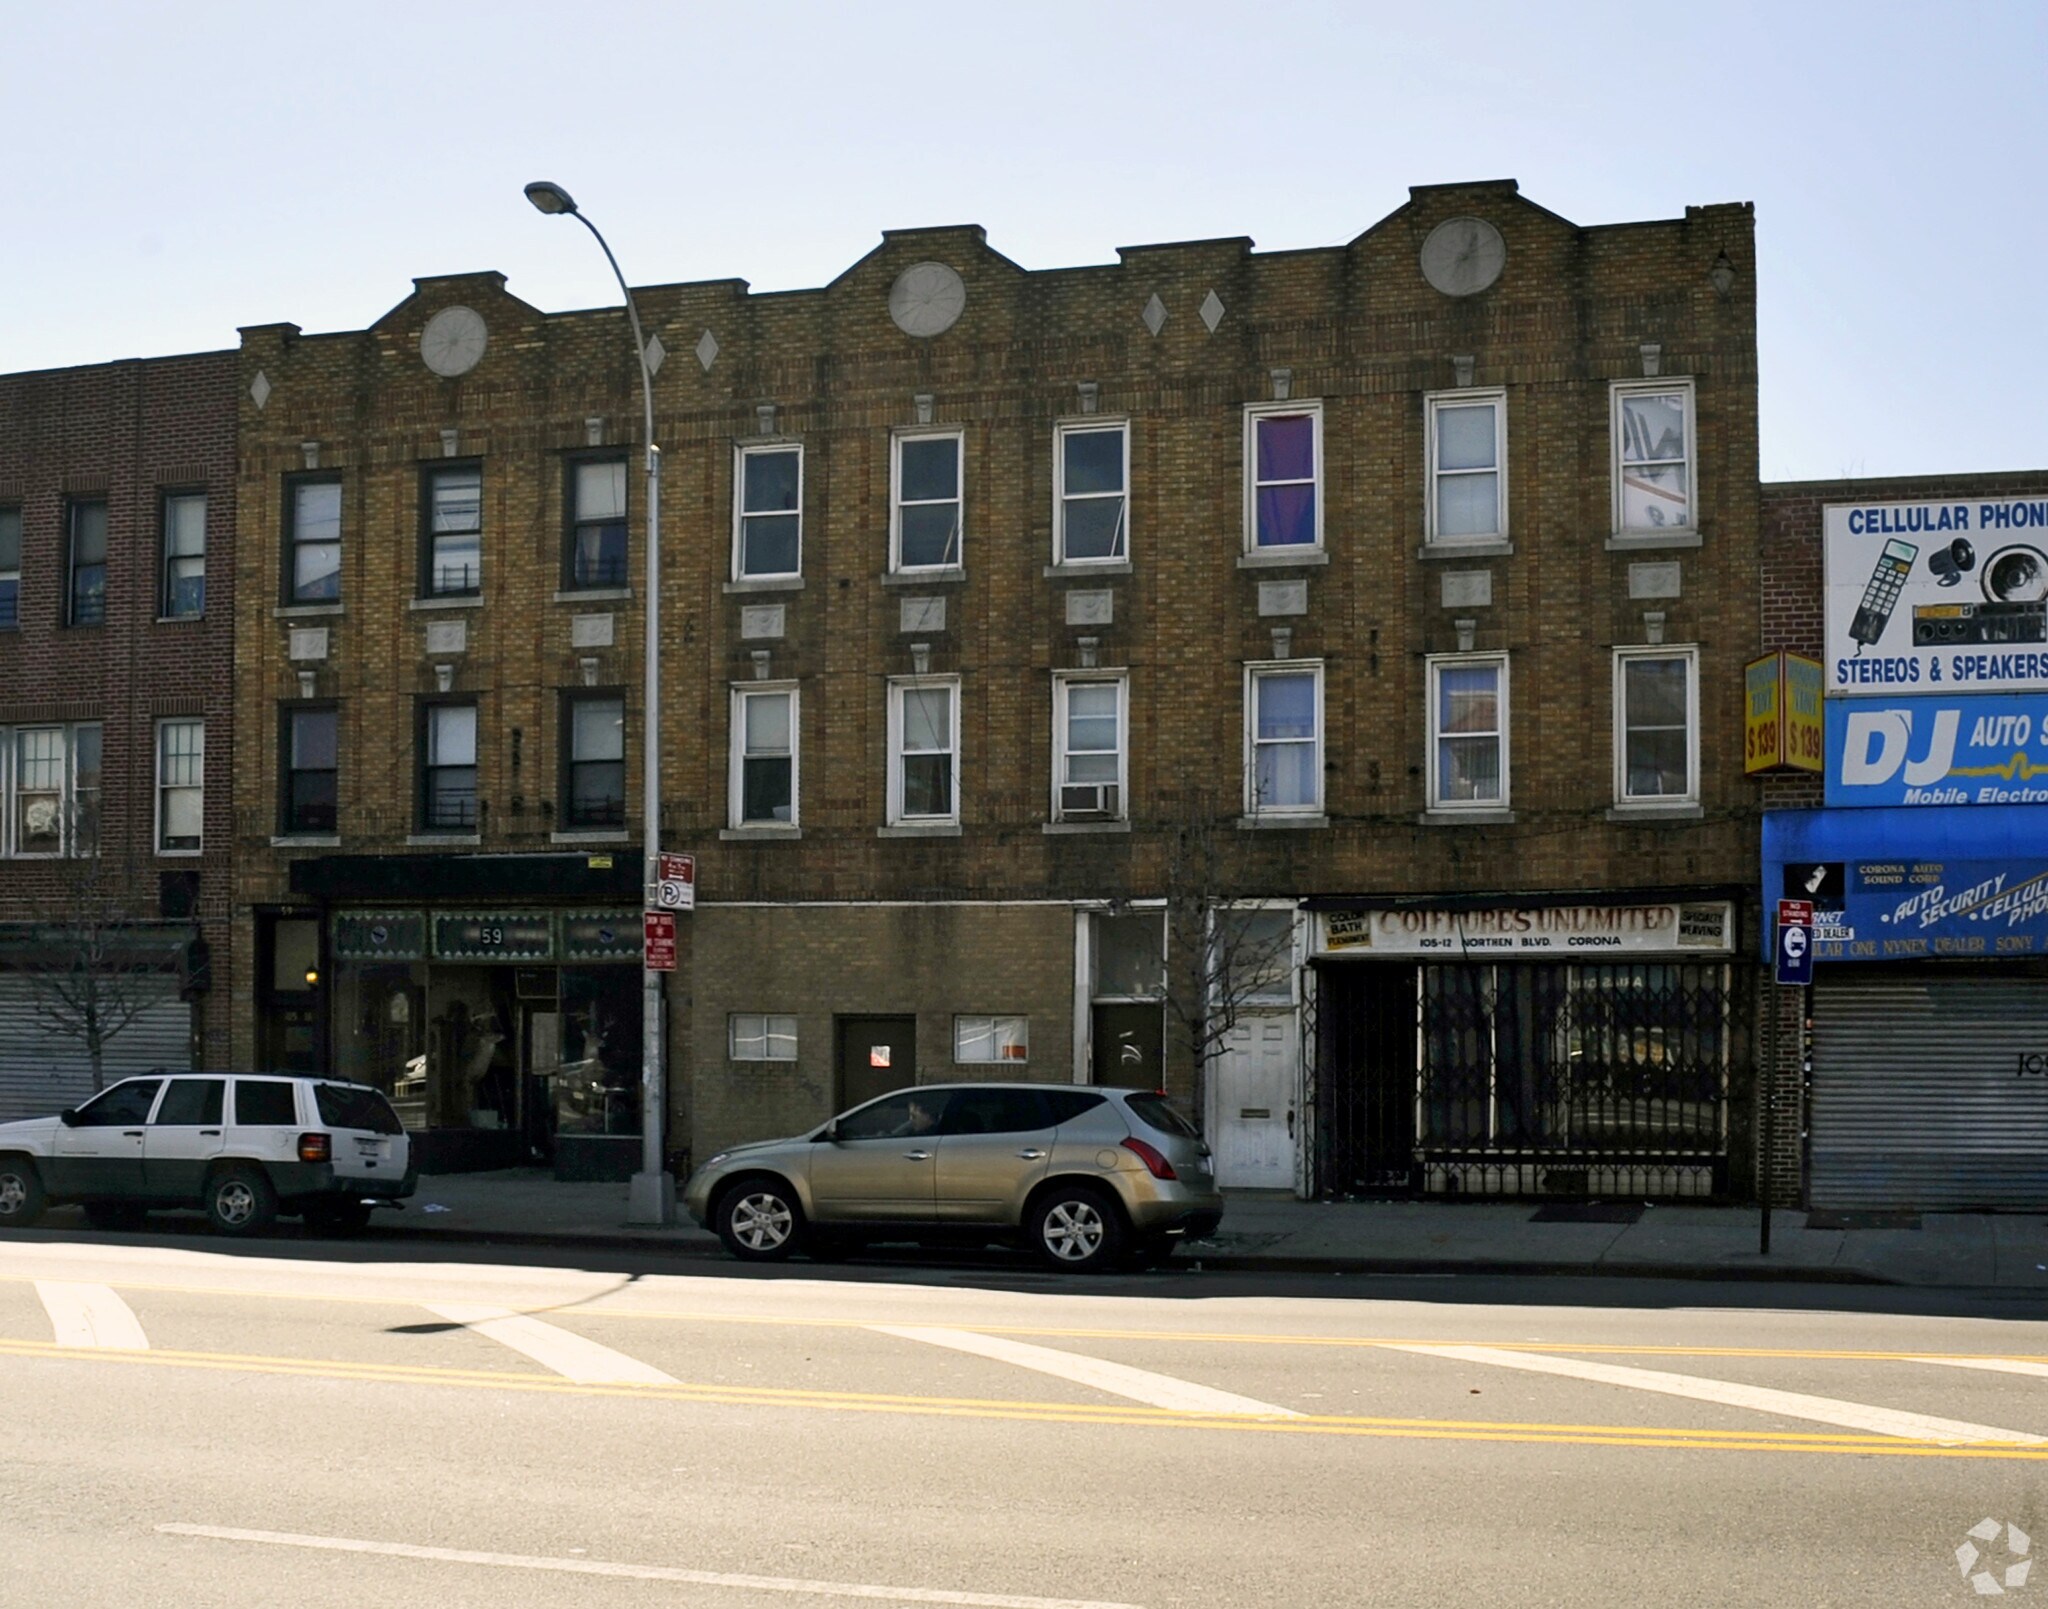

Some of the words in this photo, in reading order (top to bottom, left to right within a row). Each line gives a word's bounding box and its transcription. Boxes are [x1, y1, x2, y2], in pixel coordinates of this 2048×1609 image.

[1849, 506, 1969, 534] CELLULAR
[1980, 502, 2048, 529] PHON
[1837, 656, 1920, 684] STEREOS
[1930, 655, 1942, 682] &
[1841, 709, 1961, 787] DJ
[1969, 715, 2031, 747] AUTO
[1903, 788, 1968, 804] Mobile
[1859, 865, 1906, 874] CORONA
[1912, 864, 1944, 873] AUTO
[1864, 875, 1903, 884] SOUND
[1893, 885, 1944, 925] AUTO
[1919, 872, 2007, 929] SECURITY
[1982, 880, 2048, 920] CELLUL
[2008, 895, 2048, 927] PHO
[1331, 921, 1363, 934] BATH
[1537, 906, 1675, 932] UNLIMITED
[481, 928, 502, 944] 59
[1420, 938, 1452, 948] 105-12
[1568, 936, 1621, 946] CORONA
